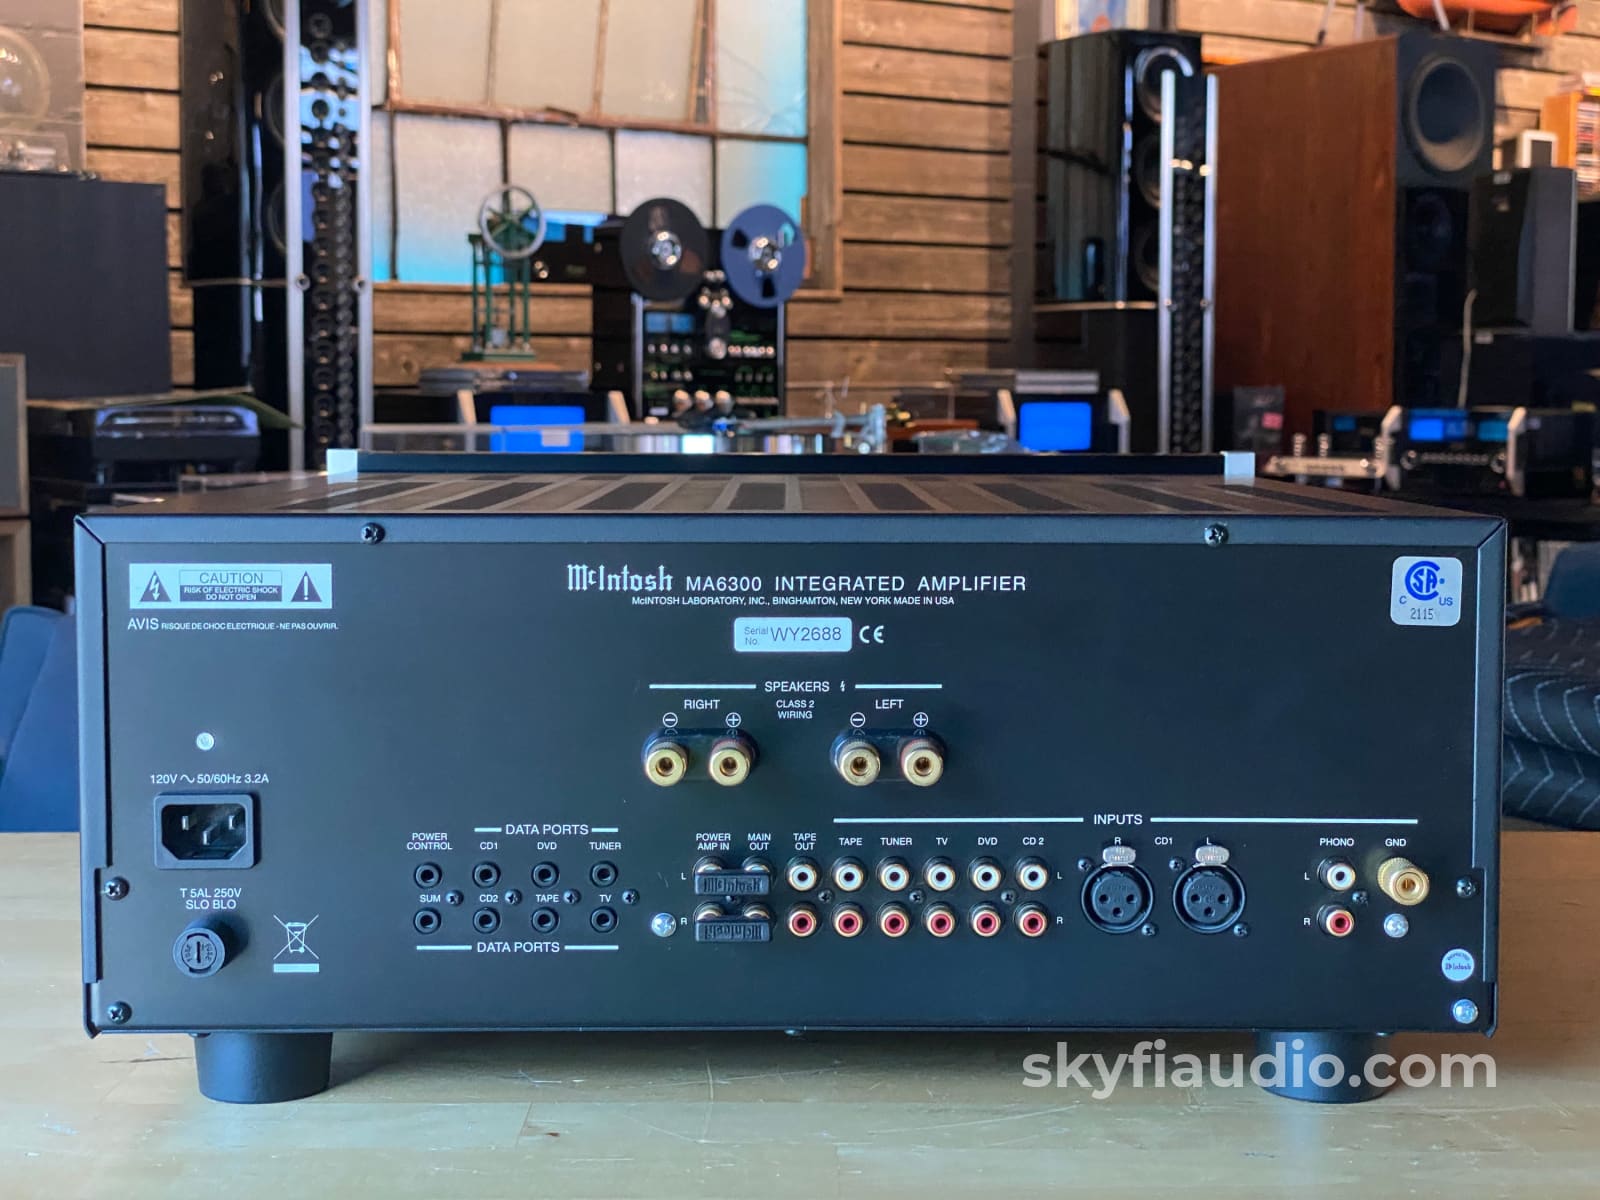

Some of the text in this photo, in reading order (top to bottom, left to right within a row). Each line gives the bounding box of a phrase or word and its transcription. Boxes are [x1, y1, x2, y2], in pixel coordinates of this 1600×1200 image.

[199, 572, 264, 584] CAUTION
[567, 563, 1027, 592] McIntosh MA6300 INTEGRATED AMPLIFIER
[183, 586, 278, 594] RISK OF ELECTRIC SHOCK
[205, 593, 257, 601] DO NOT OPEN
[631, 596, 955, 606] McINTOSH LABORATORY, INC., BINGHAMTON, NEW YORK MADE IN USA
[1399, 595, 1407, 605] C
[1439, 597, 1453, 606] US
[1410, 607, 1434, 620] 2115
[127, 617, 160, 631] AVIS
[161, 622, 191, 631] RISQUE
[191, 622, 203, 631] DE
[203, 622, 227, 631] CHOC
[227, 622, 275, 631] ELECTRIQUE
[279, 622, 291, 631] NE
[291, 622, 306, 631] PAS
[744, 626, 769, 636] Serial
[770, 626, 842, 642] WY2688
[744, 637, 760, 646] No.
[764, 681, 830, 692] SPEAKERS
[683, 699, 720, 710] RIGHT
[775, 700, 815, 709] CLASS 2
[875, 699, 904, 710] LEFT
[777, 710, 813, 720] WIRING
[150, 774, 270, 784] 120V 50/60Hz 3.2A
[1093, 814, 1143, 825] INPUTS
[505, 824, 589, 835] DATA PORTS
[411, 832, 448, 841] POWER
[695, 832, 731, 841] POWER
[747, 832, 771, 841] MAIN
[793, 832, 817, 841] TAPE
[1114, 836, 1121, 846] R
[1154, 836, 1173, 846] CD1
[1206, 836, 1212, 846] L
[406, 841, 453, 851] CONTROL
[479, 841, 498, 851] CD1
[537, 841, 557, 851] DVD
[589, 841, 622, 850] TUNER
[839, 837, 863, 846] TAPE
[880, 837, 913, 846] TUNER
[936, 837, 948, 846] TV
[977, 837, 998, 846] DVD
[1022, 837, 1045, 846] CD 2
[1319, 837, 1355, 847] PHONO
[1385, 837, 1407, 847] GND
[697, 842, 730, 851] AMP IN
[749, 842, 769, 851] OUT
[794, 842, 815, 851] OUT
[681, 872, 687, 880] L
[1057, 871, 1063, 880] L
[1304, 872, 1310, 881] L
[179, 888, 242, 898] T 5AL 250V
[419, 894, 441, 903] SUM
[479, 894, 499, 903] CD2
[535, 894, 560, 903] TAPE
[599, 894, 612, 903] TV
[185, 899, 237, 910] SLO BLO
[680, 918, 687, 926] R
[1056, 916, 1063, 925] R
[1303, 917, 1311, 926] R
[477, 942, 560, 953] DATA PORTS
